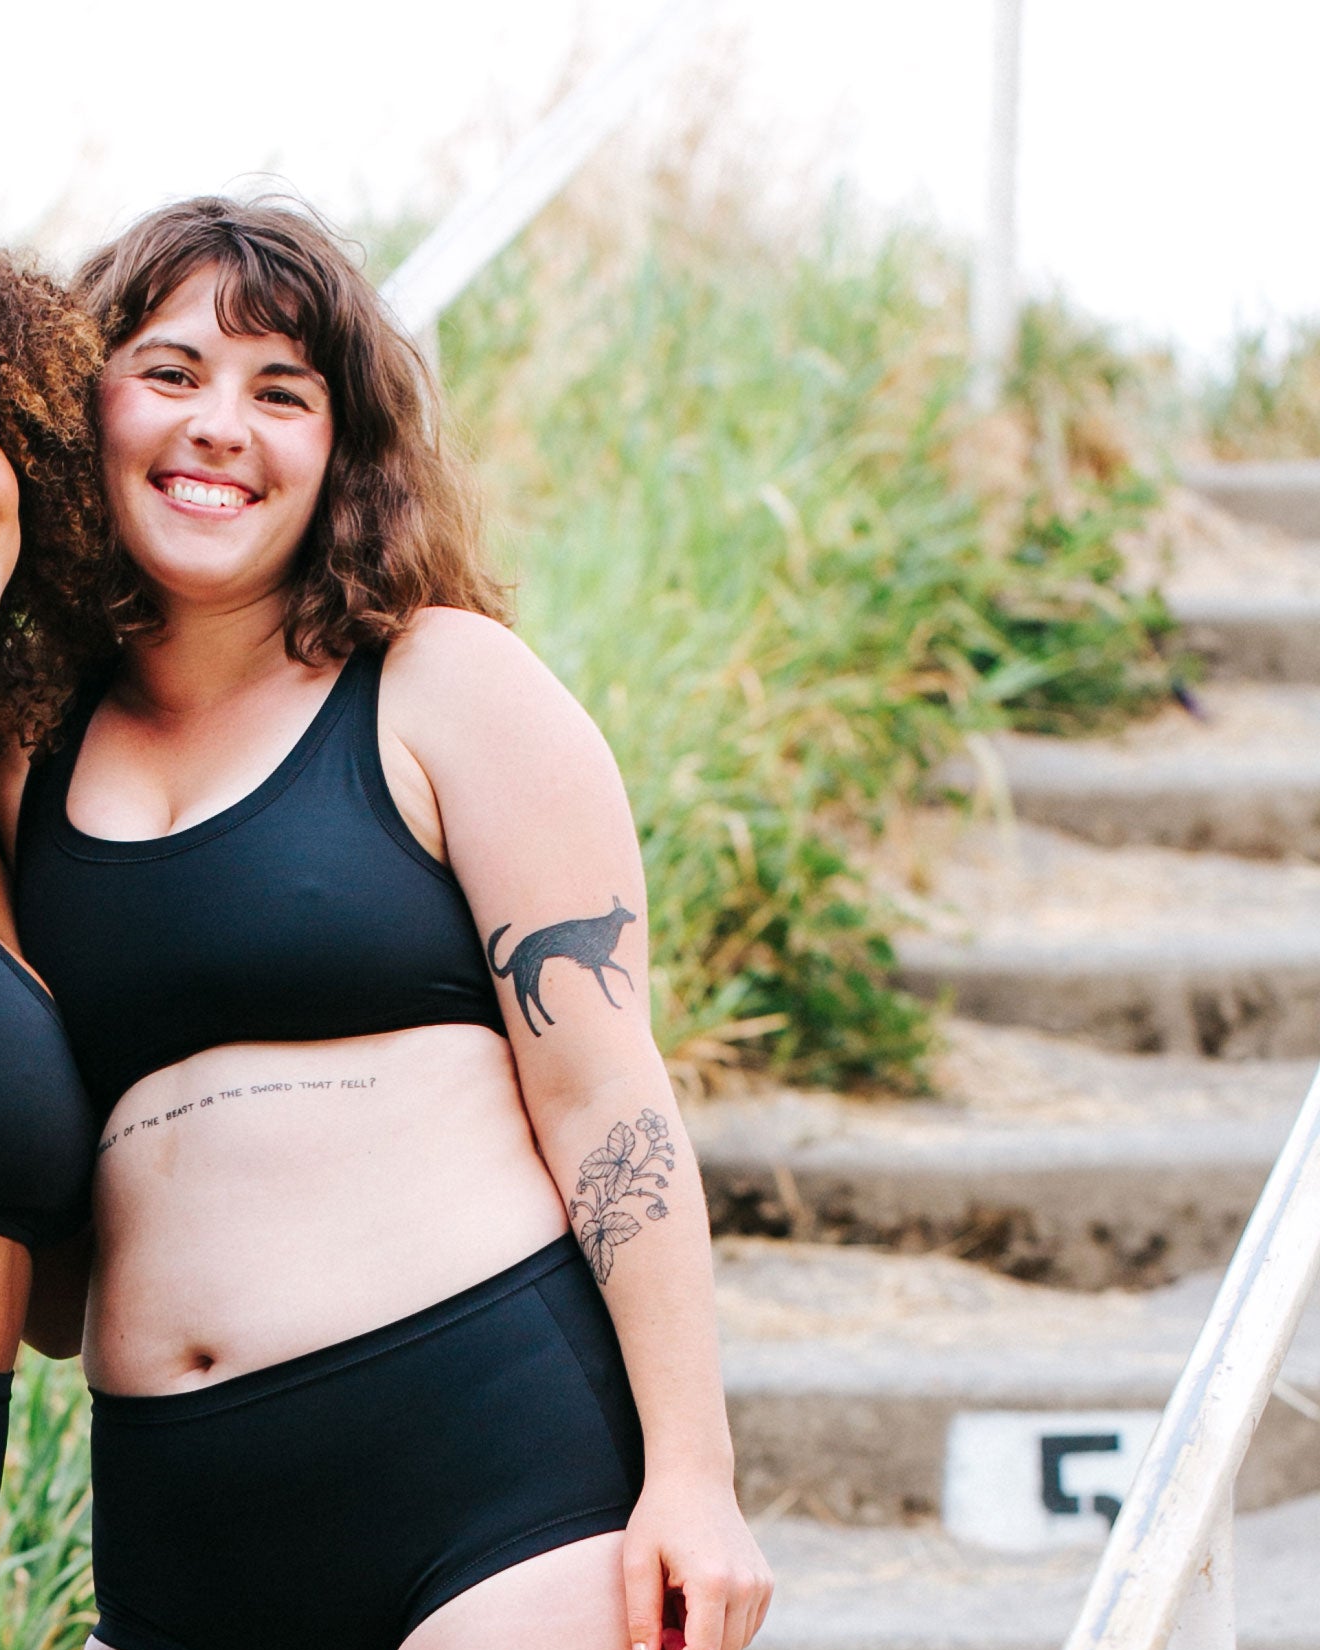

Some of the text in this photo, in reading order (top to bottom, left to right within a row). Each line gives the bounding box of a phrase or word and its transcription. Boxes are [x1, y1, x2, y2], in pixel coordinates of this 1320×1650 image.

[123, 1124, 135, 1137] OF
[141, 1116, 160, 1129] THE
[165, 1103, 194, 1121] BEAST
[200, 1096, 214, 1108] OR
[219, 1088, 243, 1099] THE
[251, 1082, 293, 1095] SWORD
[298, 1080, 332, 1090] THAT
[340, 1077, 377, 1089] FELL?
[1041, 1434, 1123, 1533] 5
